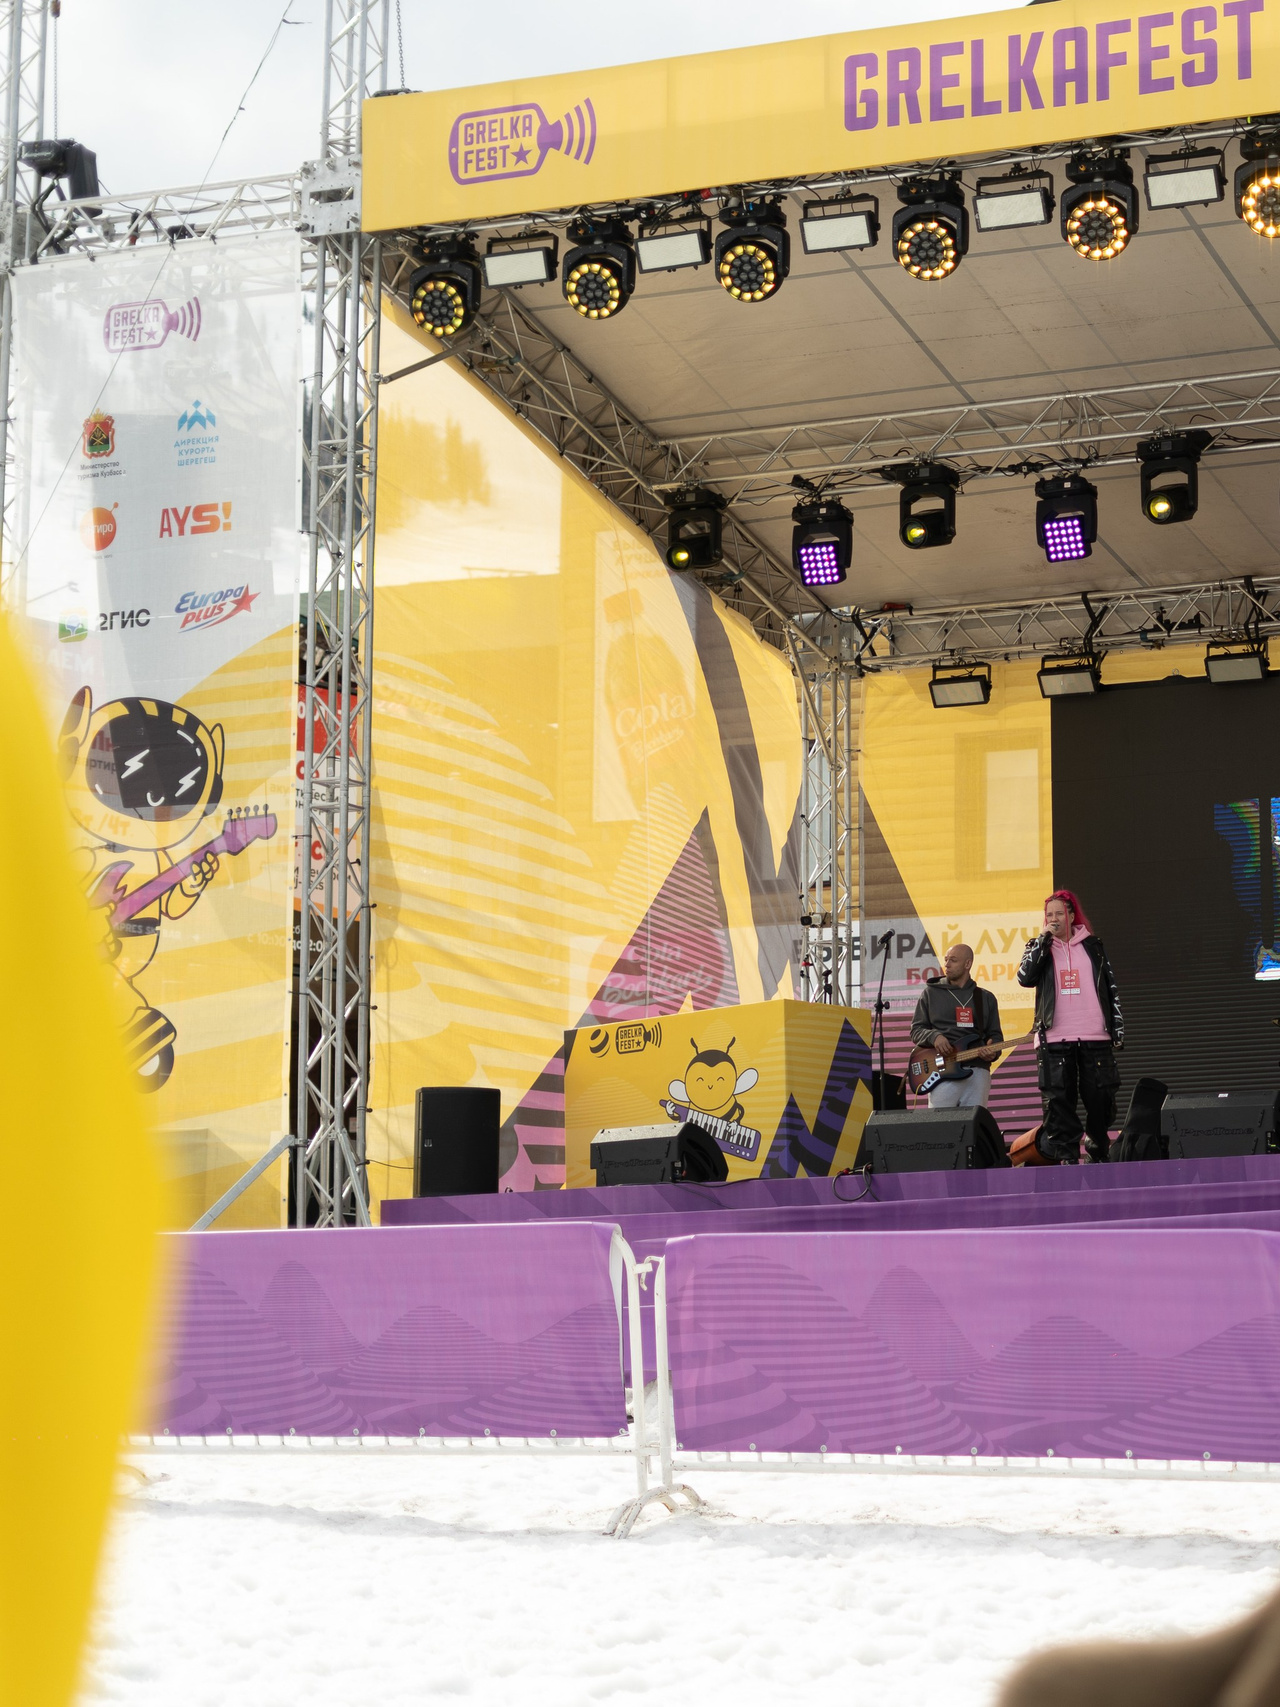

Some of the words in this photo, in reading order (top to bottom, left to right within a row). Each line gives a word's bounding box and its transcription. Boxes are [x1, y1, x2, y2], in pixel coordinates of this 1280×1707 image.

[844, 0, 1264, 132] GRELKAFEST
[463, 113, 533, 146] GRELKA
[463, 144, 510, 174] FEST
[113, 306, 160, 328] GRELKA
[113, 326, 144, 346] FEST
[174, 435, 219, 448] ДИРЕКЦИЯ
[178, 446, 215, 457] КУРОРТА
[80, 460, 120, 471] Министерство
[177, 456, 216, 467] ШЕРЕГЕШ
[159, 501, 232, 539] AYS!
[99, 608, 151, 631] 2ГИС
[906, 963, 1019, 986] БОАРИ
[619, 1027, 643, 1040] GRELKA
[620, 1039, 636, 1051] FEST
